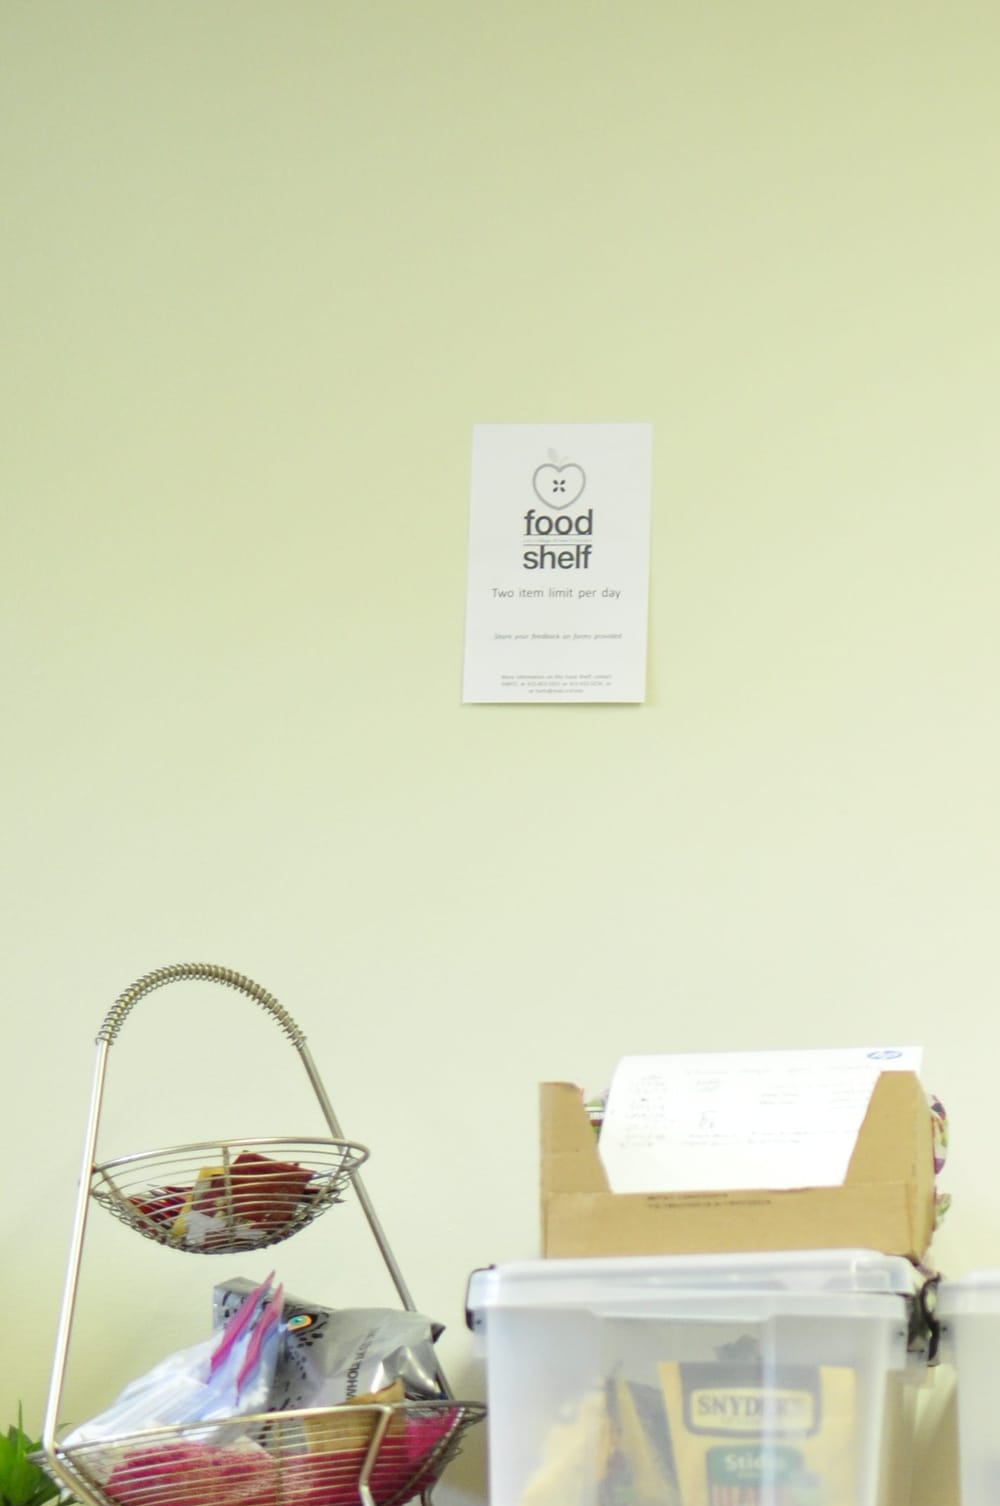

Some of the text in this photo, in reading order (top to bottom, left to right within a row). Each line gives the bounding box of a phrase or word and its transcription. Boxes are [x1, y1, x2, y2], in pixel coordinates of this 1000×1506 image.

[524, 509, 593, 535] food
[523, 545, 592, 569] shelf
[492, 588, 621, 600] Two item limit per day
